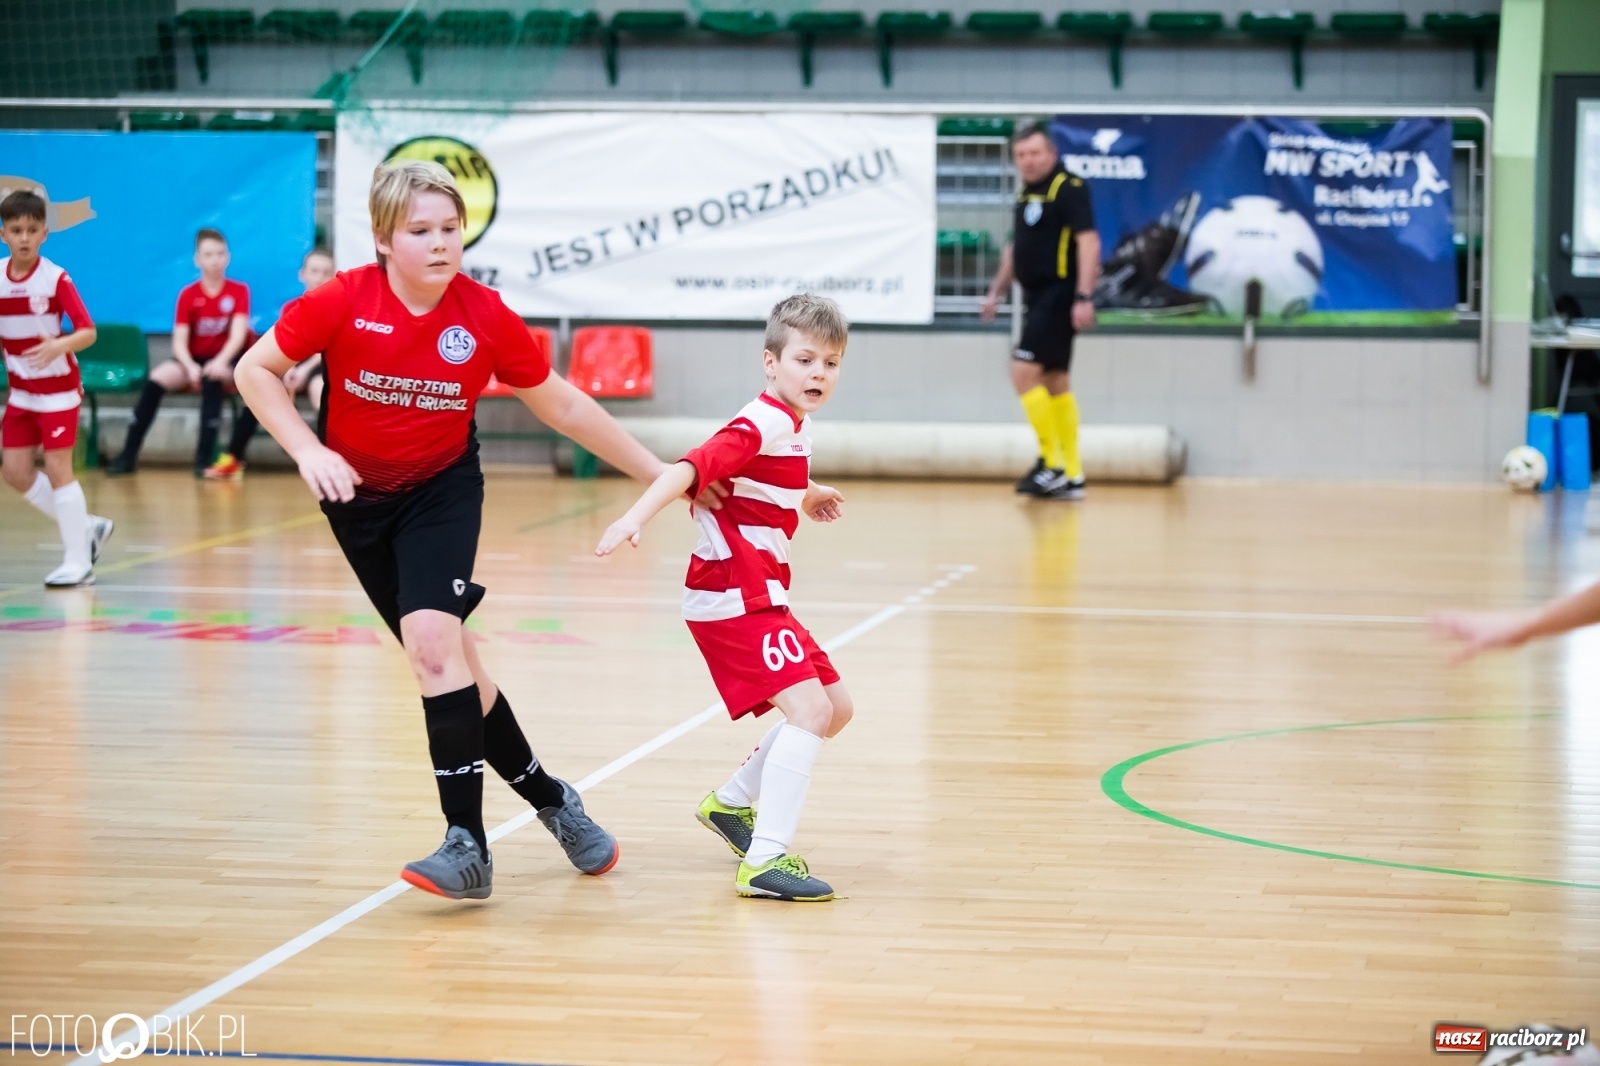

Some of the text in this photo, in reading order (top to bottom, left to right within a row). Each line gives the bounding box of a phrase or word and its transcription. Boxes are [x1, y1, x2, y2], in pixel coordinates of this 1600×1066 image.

[1263, 151, 1412, 178] MW SPORT
[527, 147, 900, 281] JEST W PORZĄDKU!
[344, 378, 414, 408] RADOSŁAW
[359, 369, 462, 397] UBEZPIECZENIA
[762, 628, 805, 672] 60
[433, 765, 472, 776] OLO
